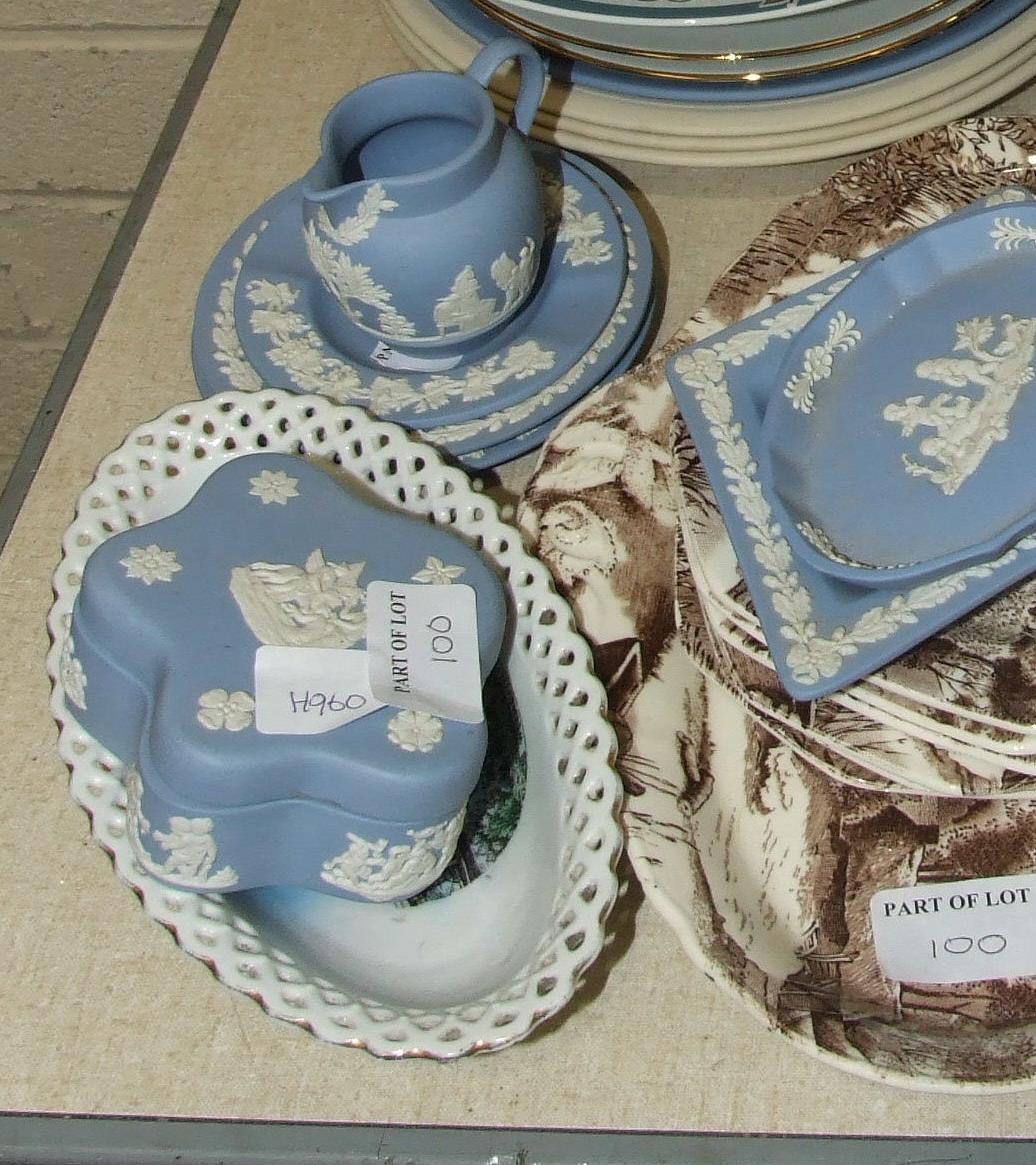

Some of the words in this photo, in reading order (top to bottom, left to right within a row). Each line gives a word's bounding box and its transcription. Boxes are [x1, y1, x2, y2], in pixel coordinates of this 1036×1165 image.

[390, 590, 408, 626] LOT
[391, 628, 409, 652] OF
[426, 614, 458, 664] 100
[390, 654, 410, 693] PART
[289, 689, 367, 717] H960
[883, 896, 943, 917] PART
[949, 892, 979, 910] OF
[984, 887, 1031, 907] LOT
[931, 934, 1008, 959] 100
